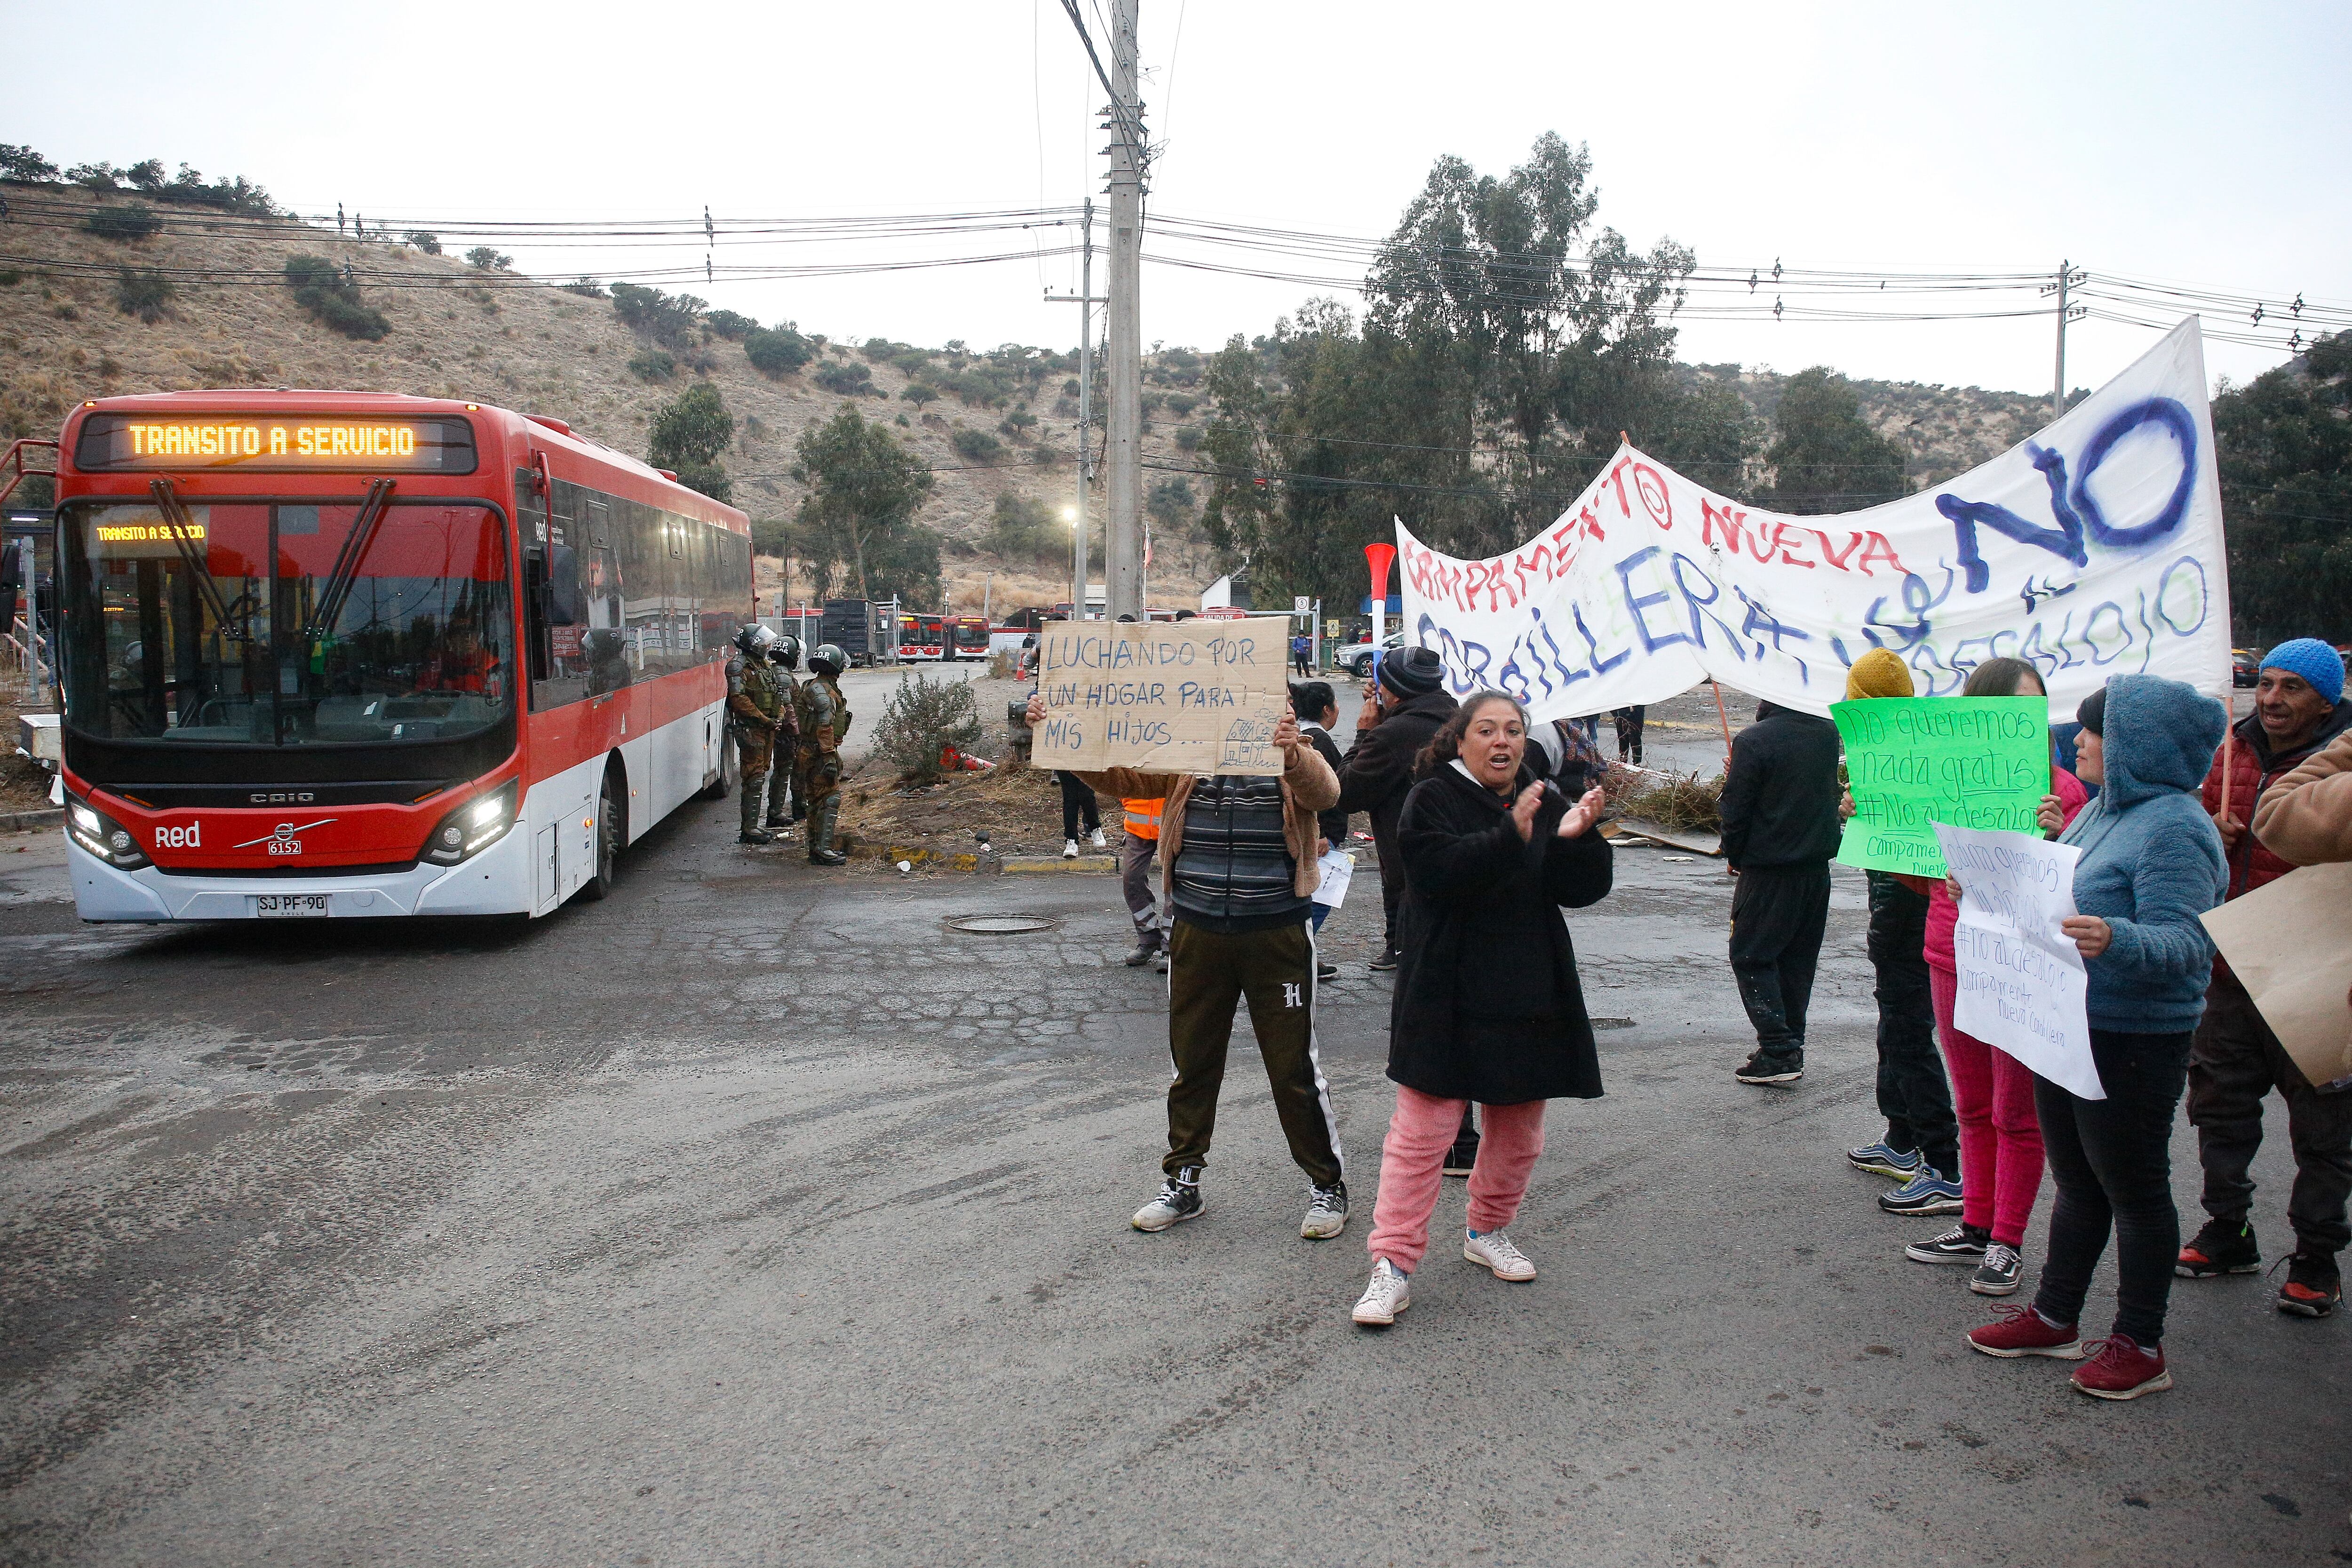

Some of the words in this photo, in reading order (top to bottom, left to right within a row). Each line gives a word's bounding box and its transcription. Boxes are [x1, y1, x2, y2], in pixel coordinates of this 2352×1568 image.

[129, 425, 261, 455] TRANSITO
[270, 425, 288, 455] A
[297, 425, 415, 455] SERVICIO
[1935, 396, 2198, 594] NO
[96, 526, 147, 541] TRANSITO
[148, 525, 158, 540] A
[1701, 497, 1912, 577] NUEVA
[1046, 636, 1195, 671] LUCHANDO
[1207, 637, 1255, 667] POR
[1049, 683, 1076, 707] UN
[1087, 683, 1166, 709] HOGAR
[1178, 681, 1235, 708] PARA
[1045, 711, 1082, 750] MIS
[1895, 708, 2035, 745] queremos
[1862, 749, 1931, 786] nada
[1941, 748, 2035, 803] gratis
[155, 820, 201, 848] Red
[1954, 799, 2040, 836] desaloj
[270, 842, 300, 854] 6152
